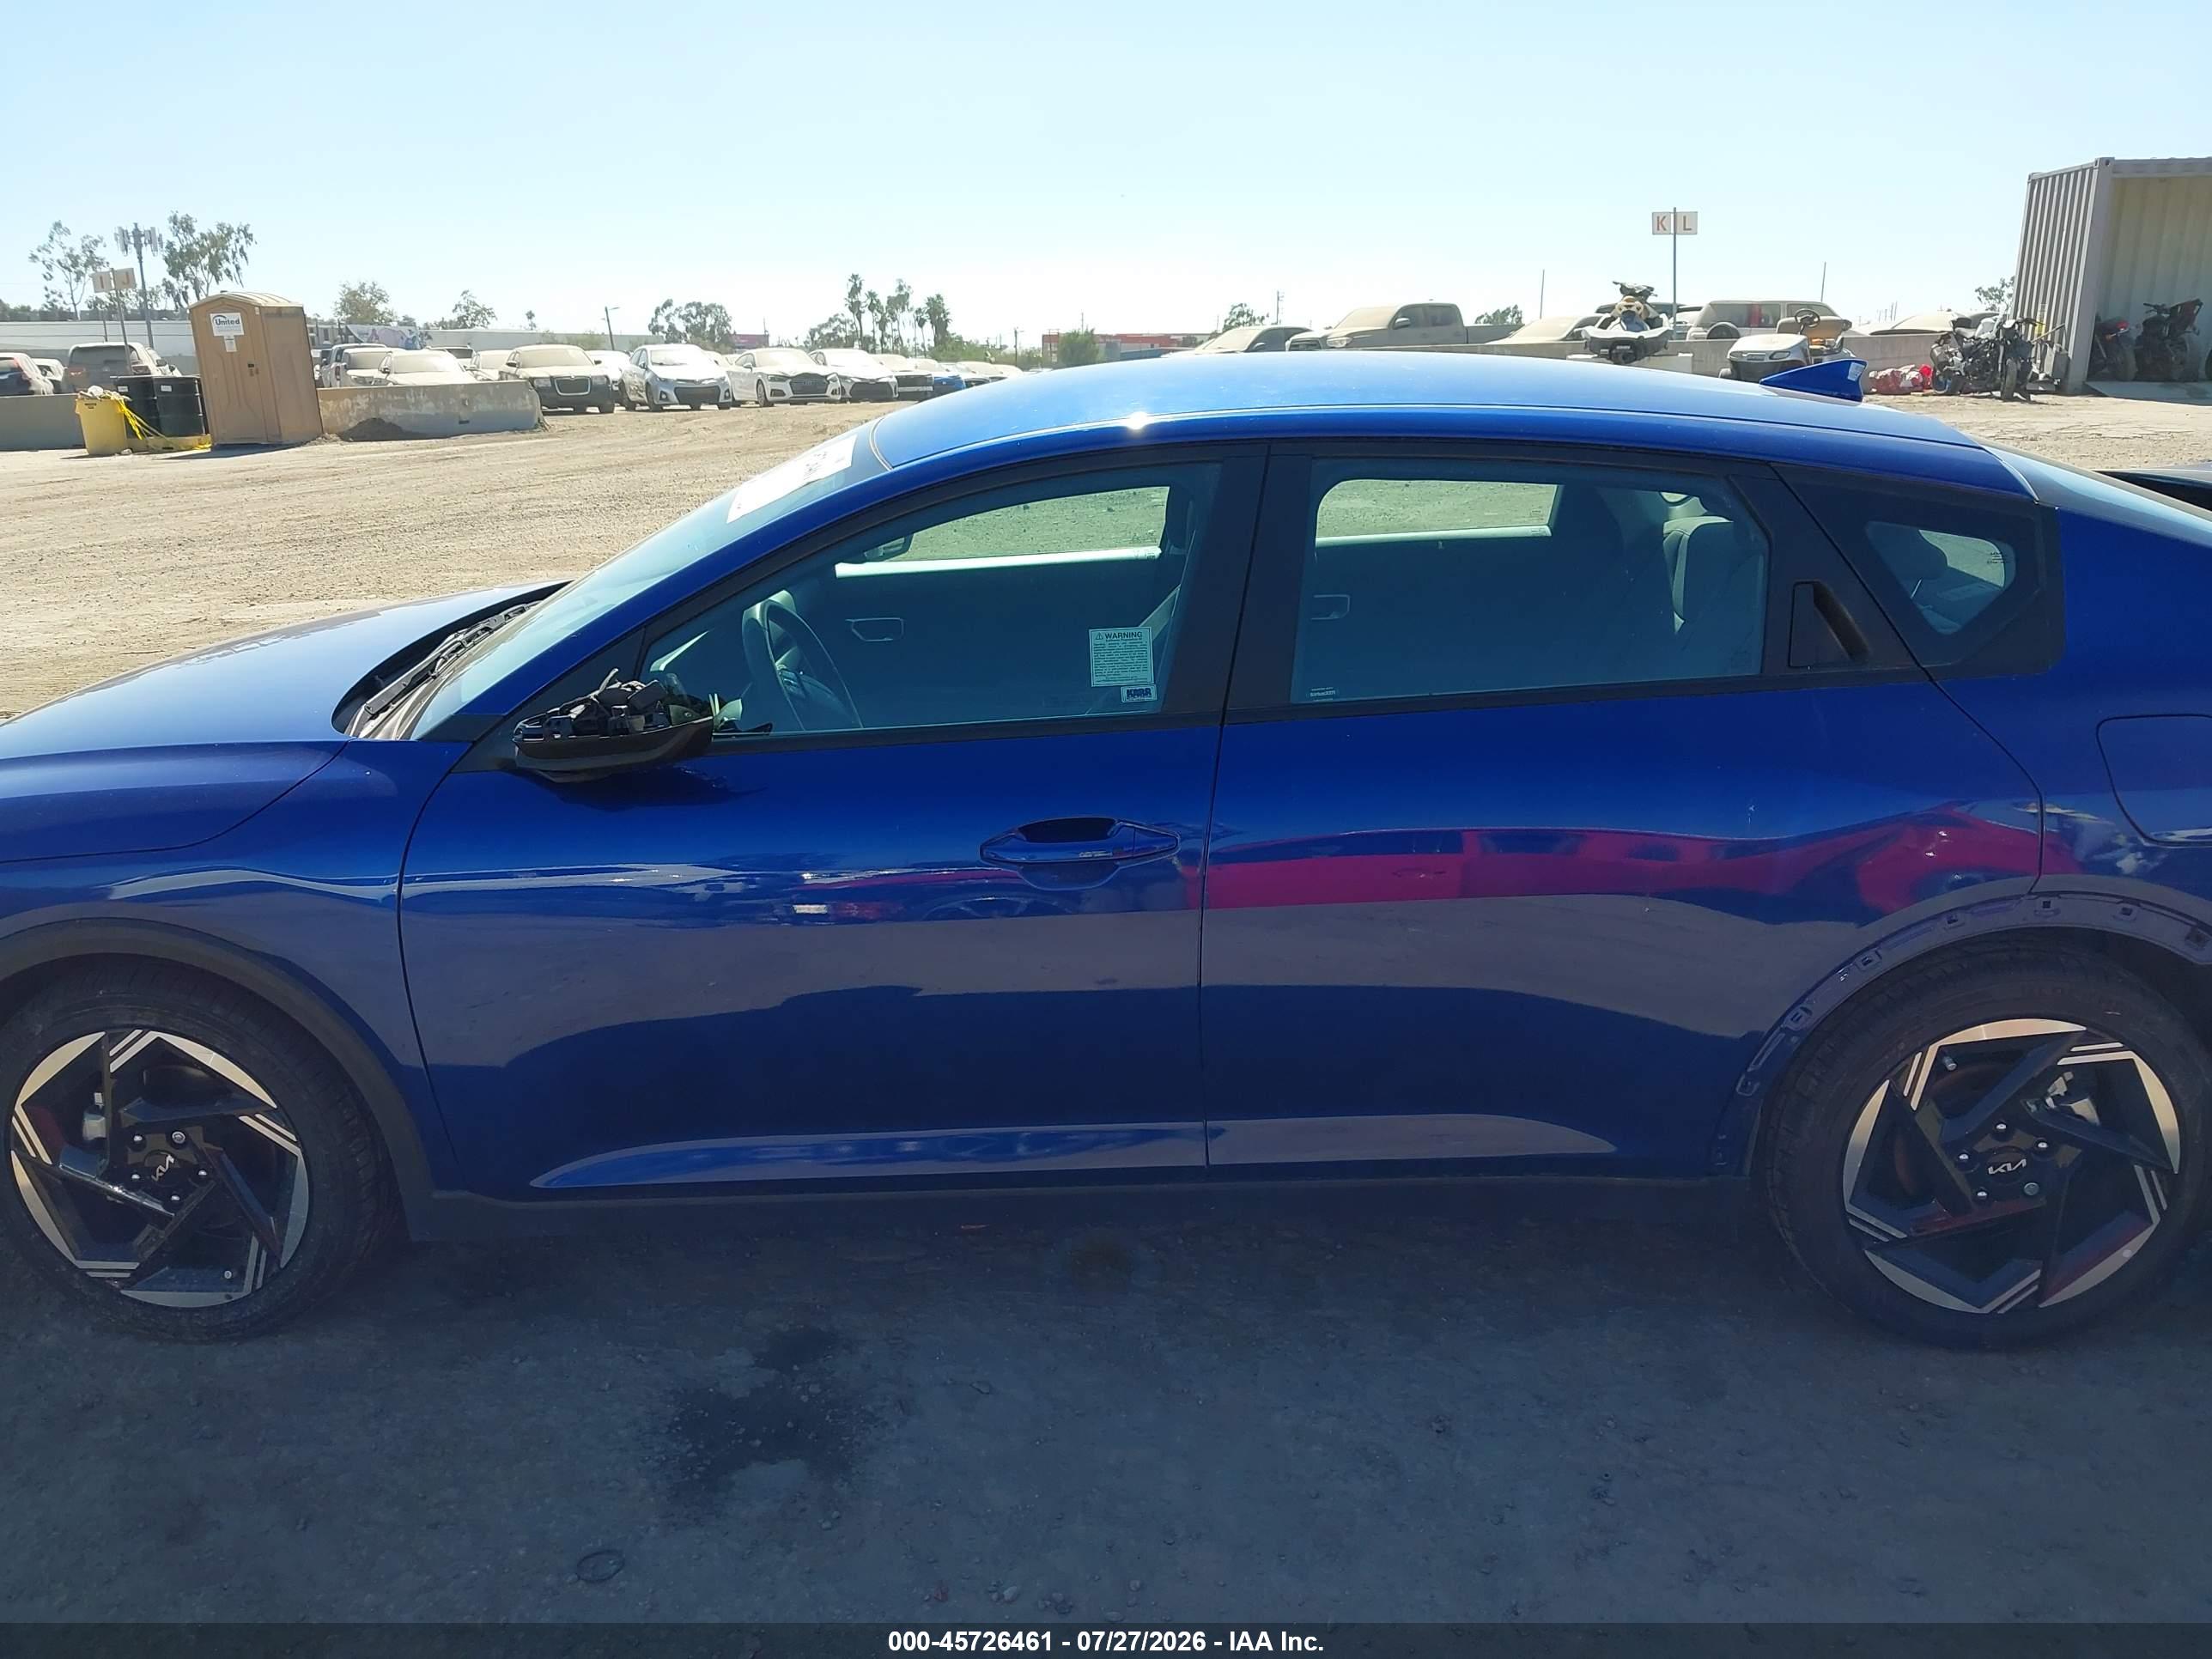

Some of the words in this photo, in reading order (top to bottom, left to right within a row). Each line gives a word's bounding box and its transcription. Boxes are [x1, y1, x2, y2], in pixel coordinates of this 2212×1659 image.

[1656, 216, 1667, 231] K
[1683, 216, 1692, 231] L
[122, 271, 130, 285] J
[215, 317, 240, 325] United
